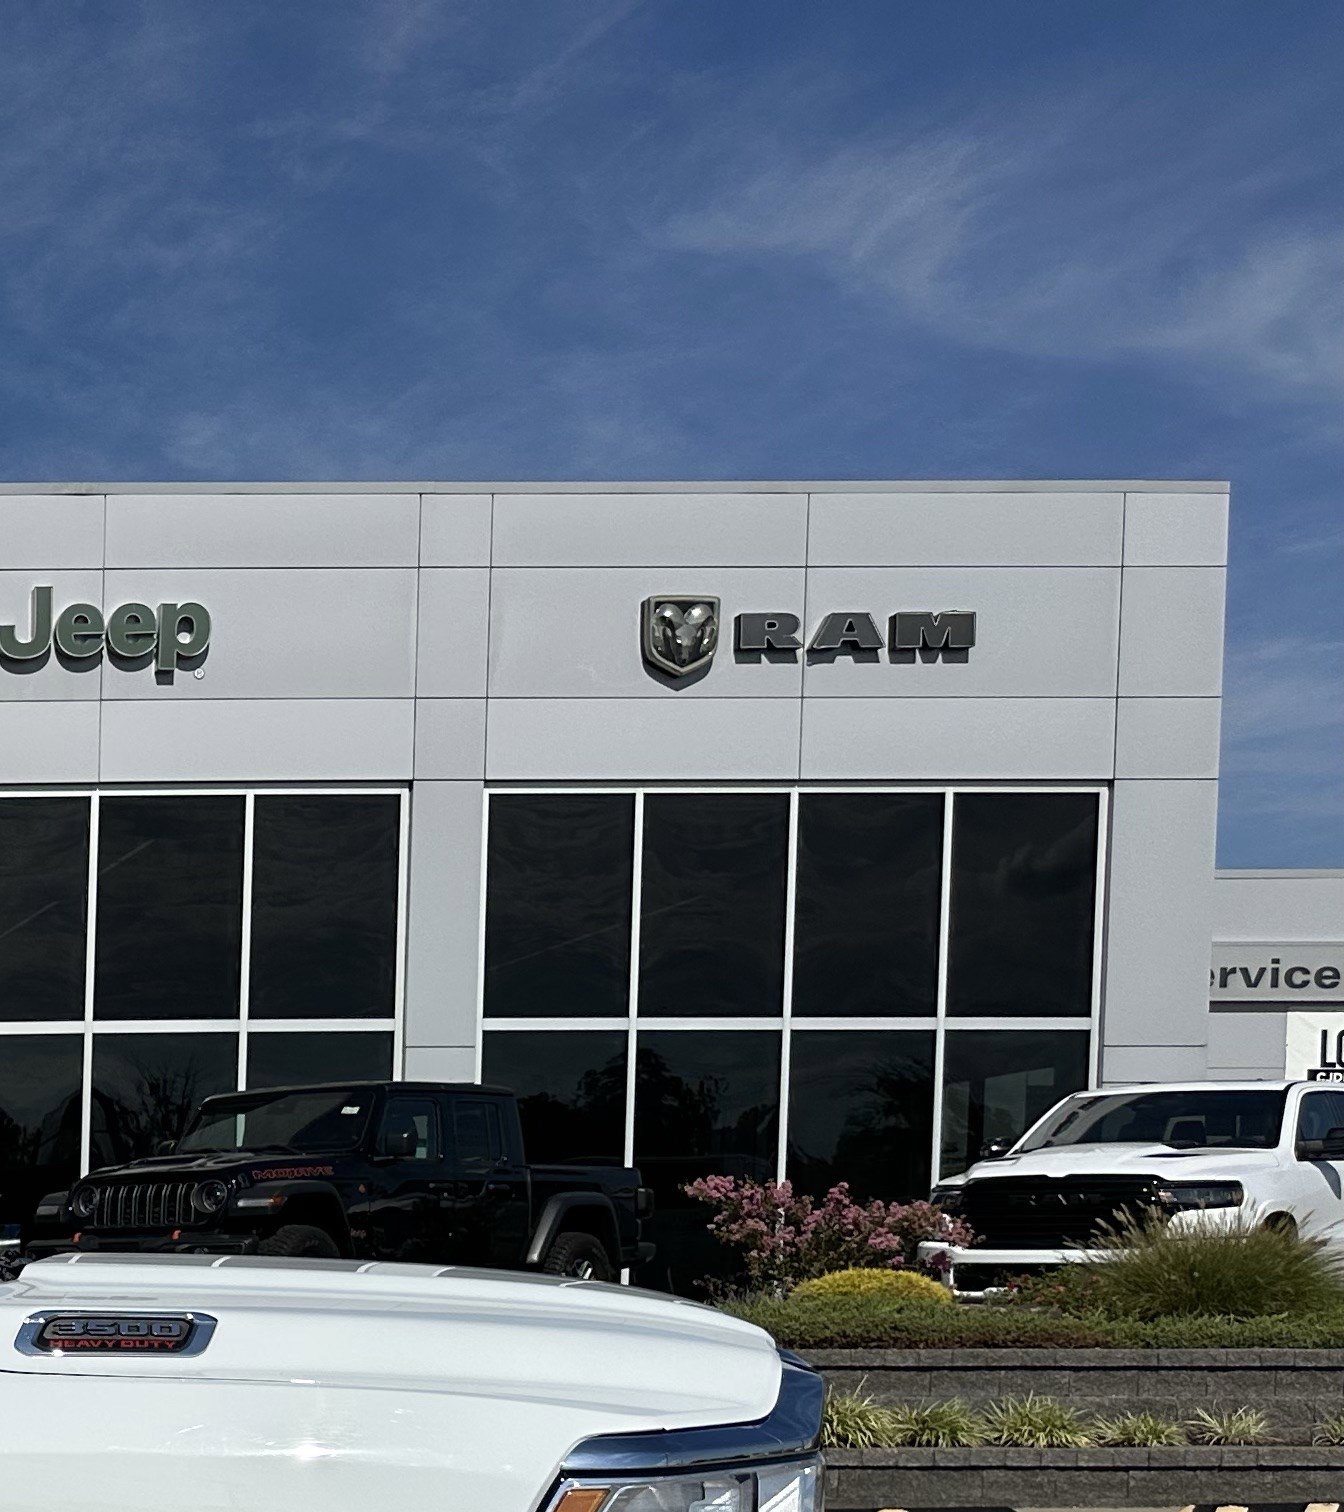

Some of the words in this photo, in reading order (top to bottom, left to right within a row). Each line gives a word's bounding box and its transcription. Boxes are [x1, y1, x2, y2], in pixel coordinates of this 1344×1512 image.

[734, 612, 976, 649] RAM
[1210, 958, 1341, 989] rvice
[52, 1321, 182, 1337] 3500
[48, 1339, 114, 1348] HEAVY
[120, 1340, 177, 1350] DUTY
